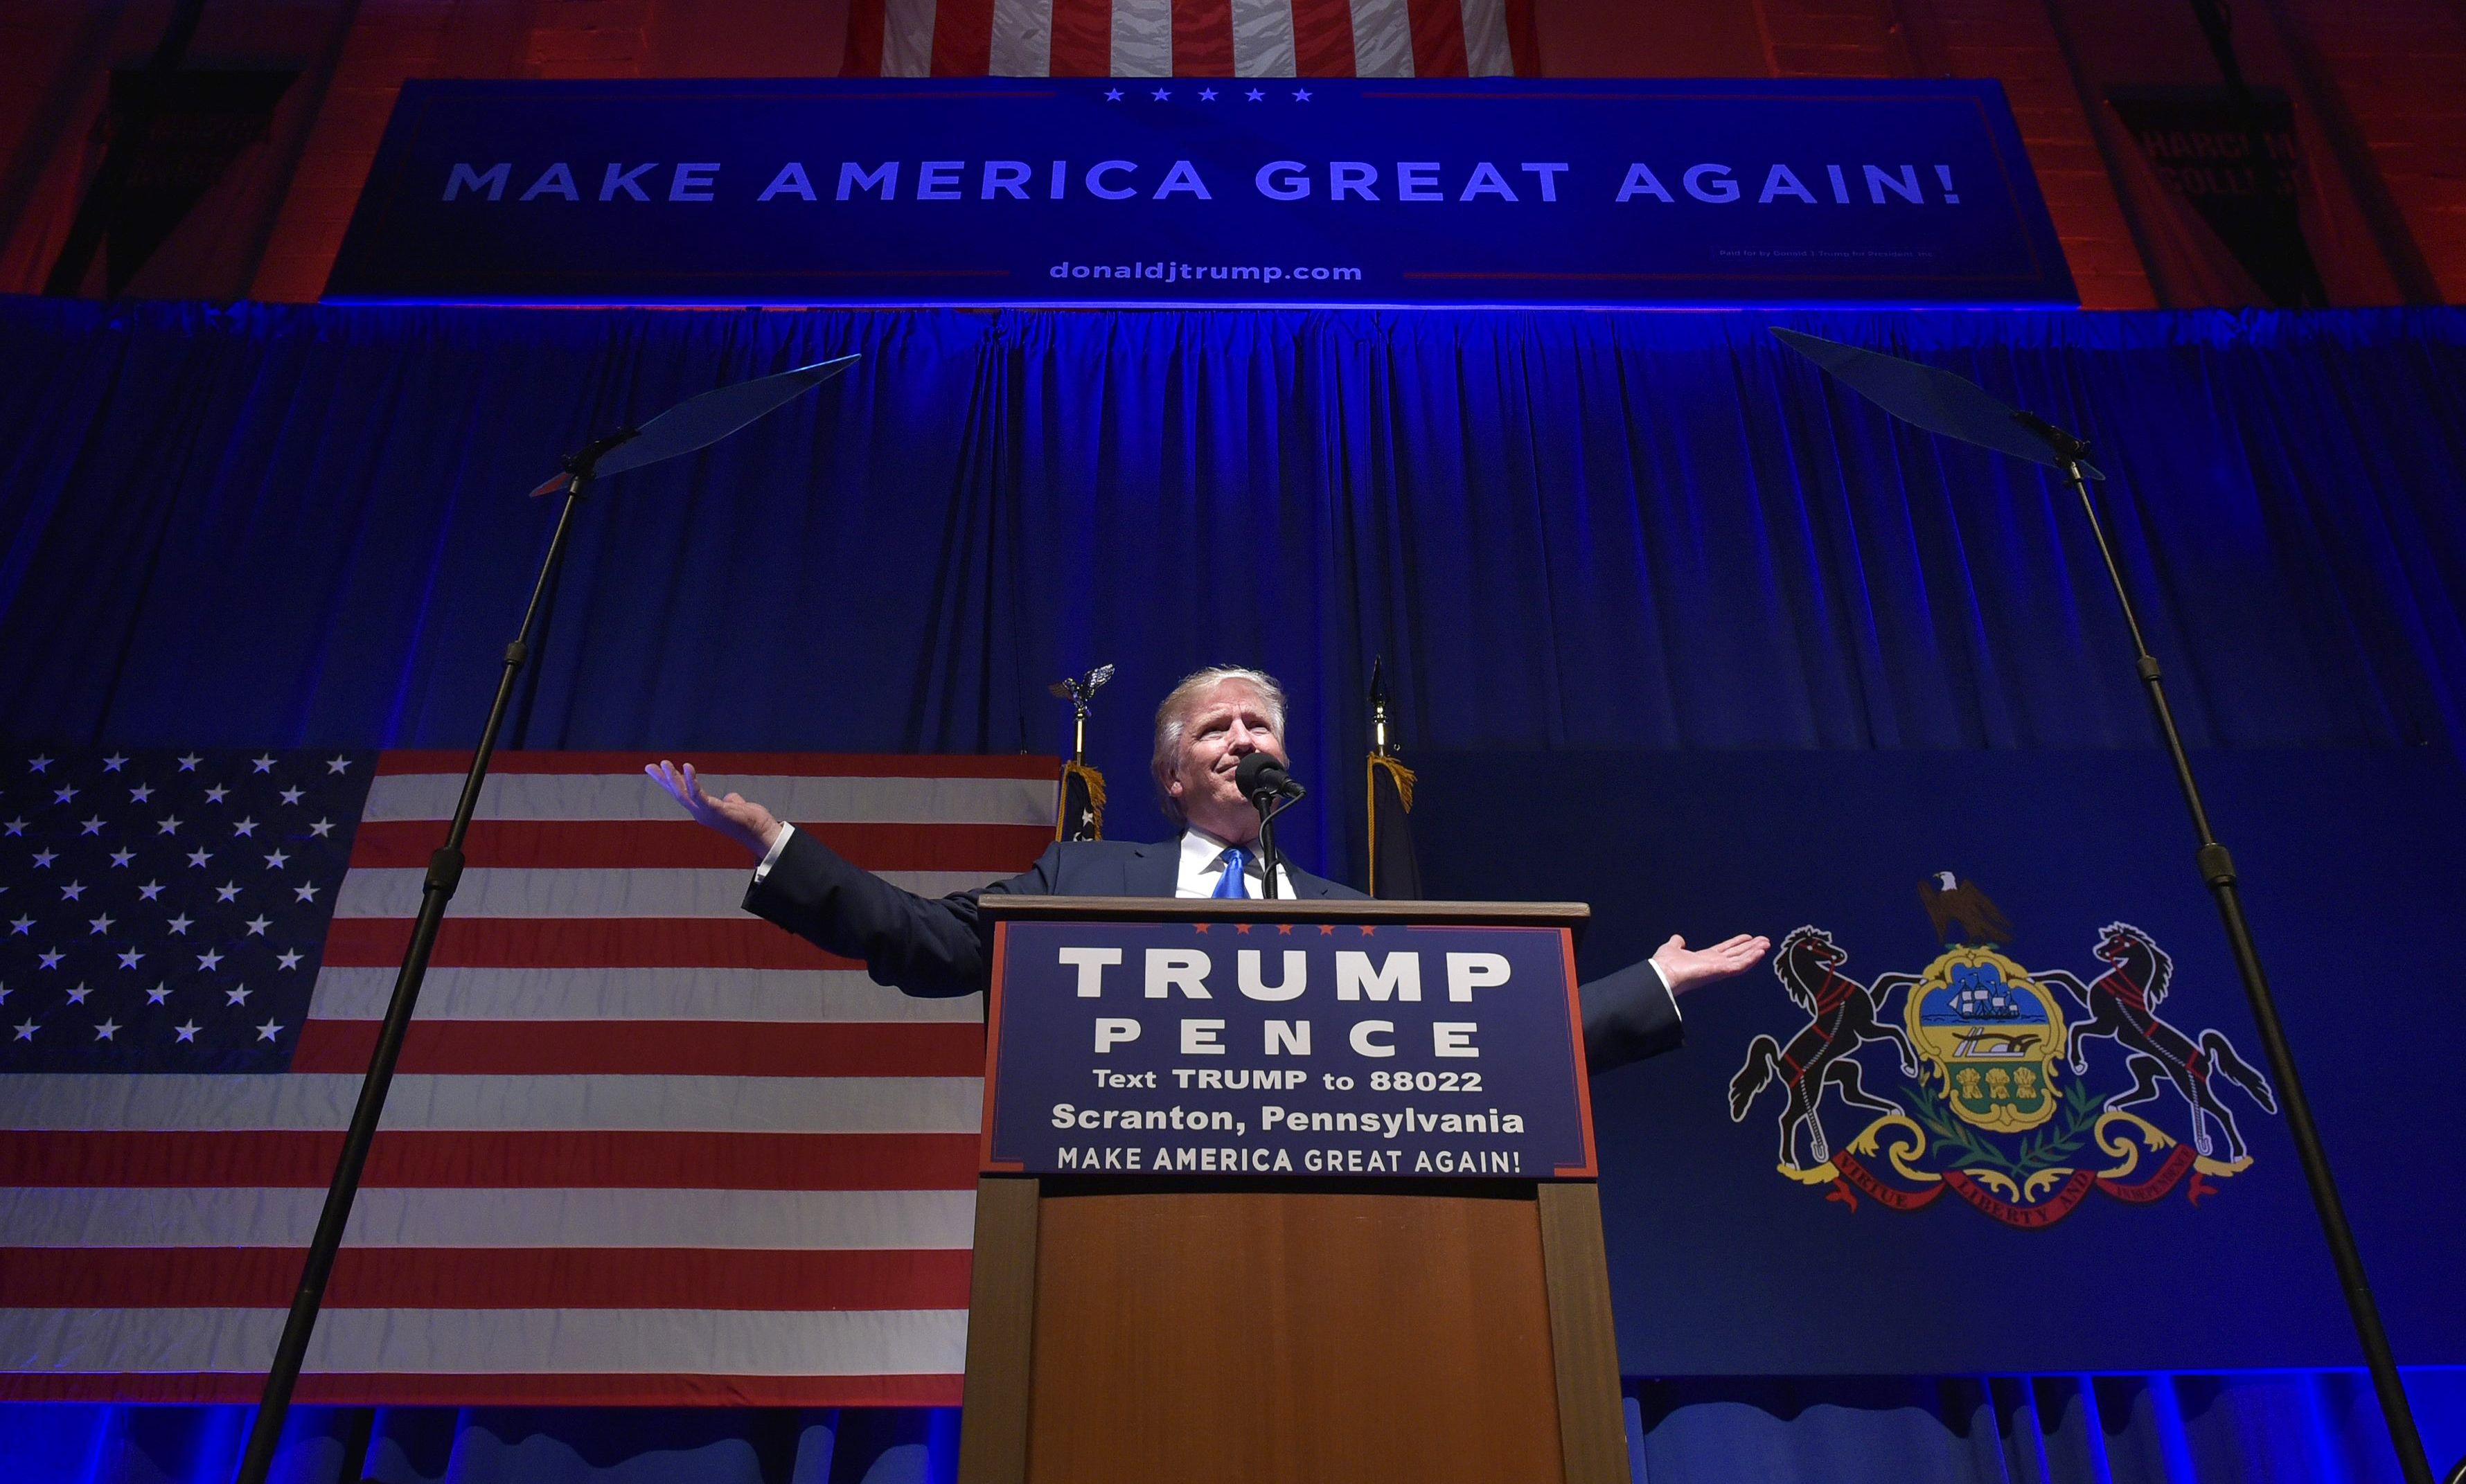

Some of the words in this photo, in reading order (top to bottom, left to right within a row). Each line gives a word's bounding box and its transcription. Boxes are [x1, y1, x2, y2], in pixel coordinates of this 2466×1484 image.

[442, 162, 720, 202] MAKE
[758, 161, 1212, 201] AMERICA
[1255, 161, 1569, 202] GREAT
[1615, 162, 1961, 204] AGAIN!
[1049, 261, 1362, 284] donaldjtrump.com
[1058, 947, 1511, 1002] TRUMP
[1094, 1017, 1480, 1057] PENCE
[1092, 1069, 1157, 1089] Text
[1172, 1069, 1308, 1091] TRUMP
[1322, 1072, 1354, 1091] to
[1370, 1071, 1483, 1092] 88022
[1052, 1103, 1245, 1136] Scranton,
[1262, 1106, 1525, 1139] Pennsylvania
[1058, 1147, 1142, 1170] MAKE
[1153, 1147, 1293, 1172] AMERICA
[1304, 1149, 1402, 1172] GREAT
[1414, 1150, 1521, 1174] AGAIN!
[1840, 1154, 1907, 1208] VIRTUE
[1958, 1179, 2048, 1224] LIBERTY
[2059, 1172, 2088, 1208] AND
